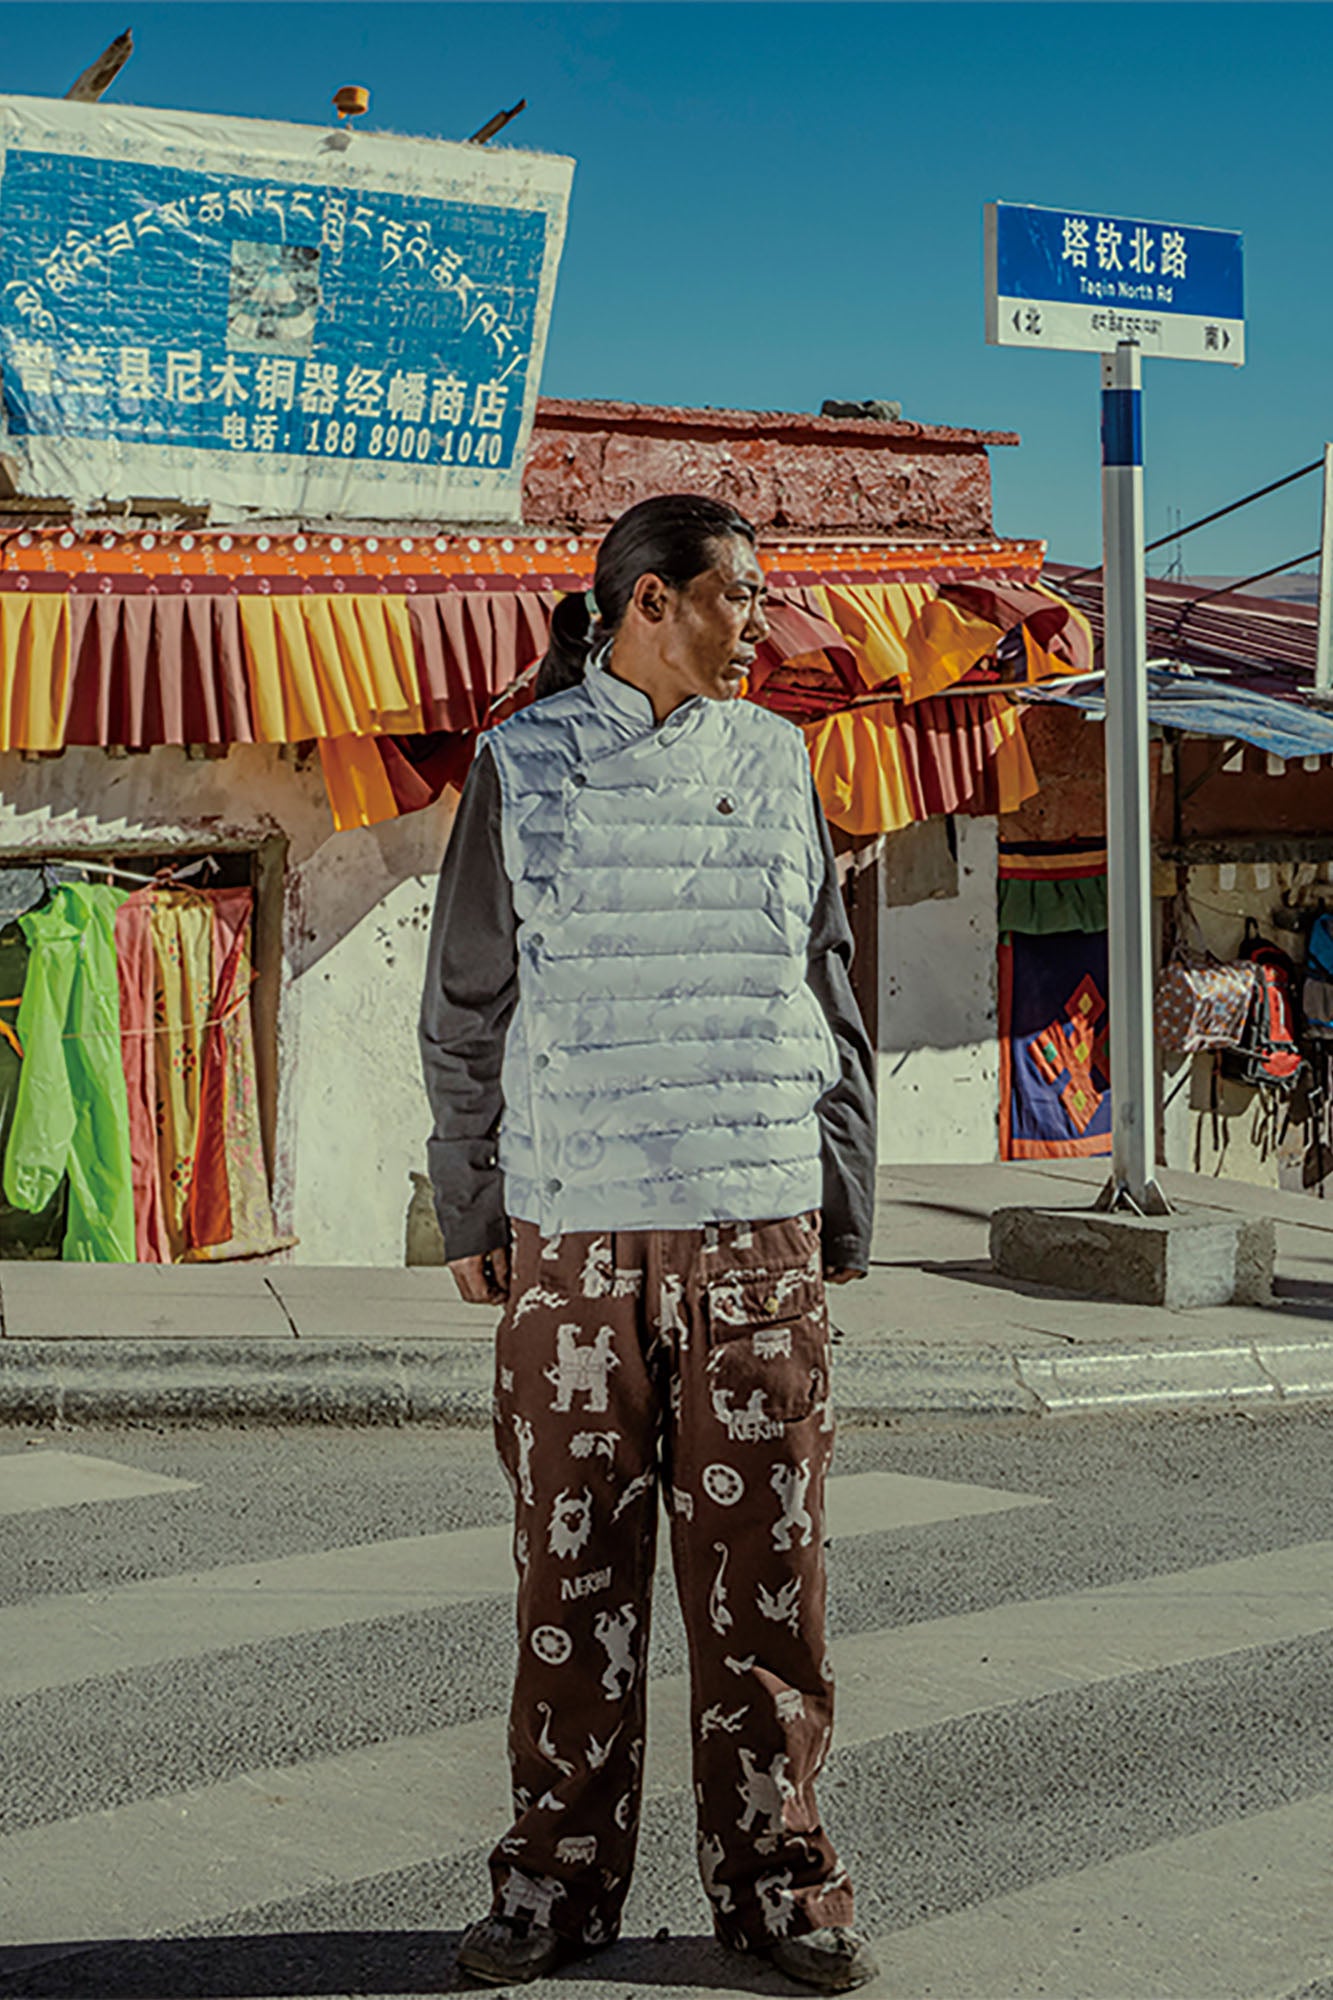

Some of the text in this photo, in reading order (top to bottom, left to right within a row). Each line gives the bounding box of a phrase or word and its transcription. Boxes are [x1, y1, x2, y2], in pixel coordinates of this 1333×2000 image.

[1061, 217, 1188, 279] 塔钦北路
[1080, 276, 1173, 303] Taqin North Rd
[9, 339, 509, 429] 普兰县尼木铜器经幡商店
[306, 419, 357, 454] 188
[368, 424, 431, 460] 8900
[442, 430, 503, 465] 1040
